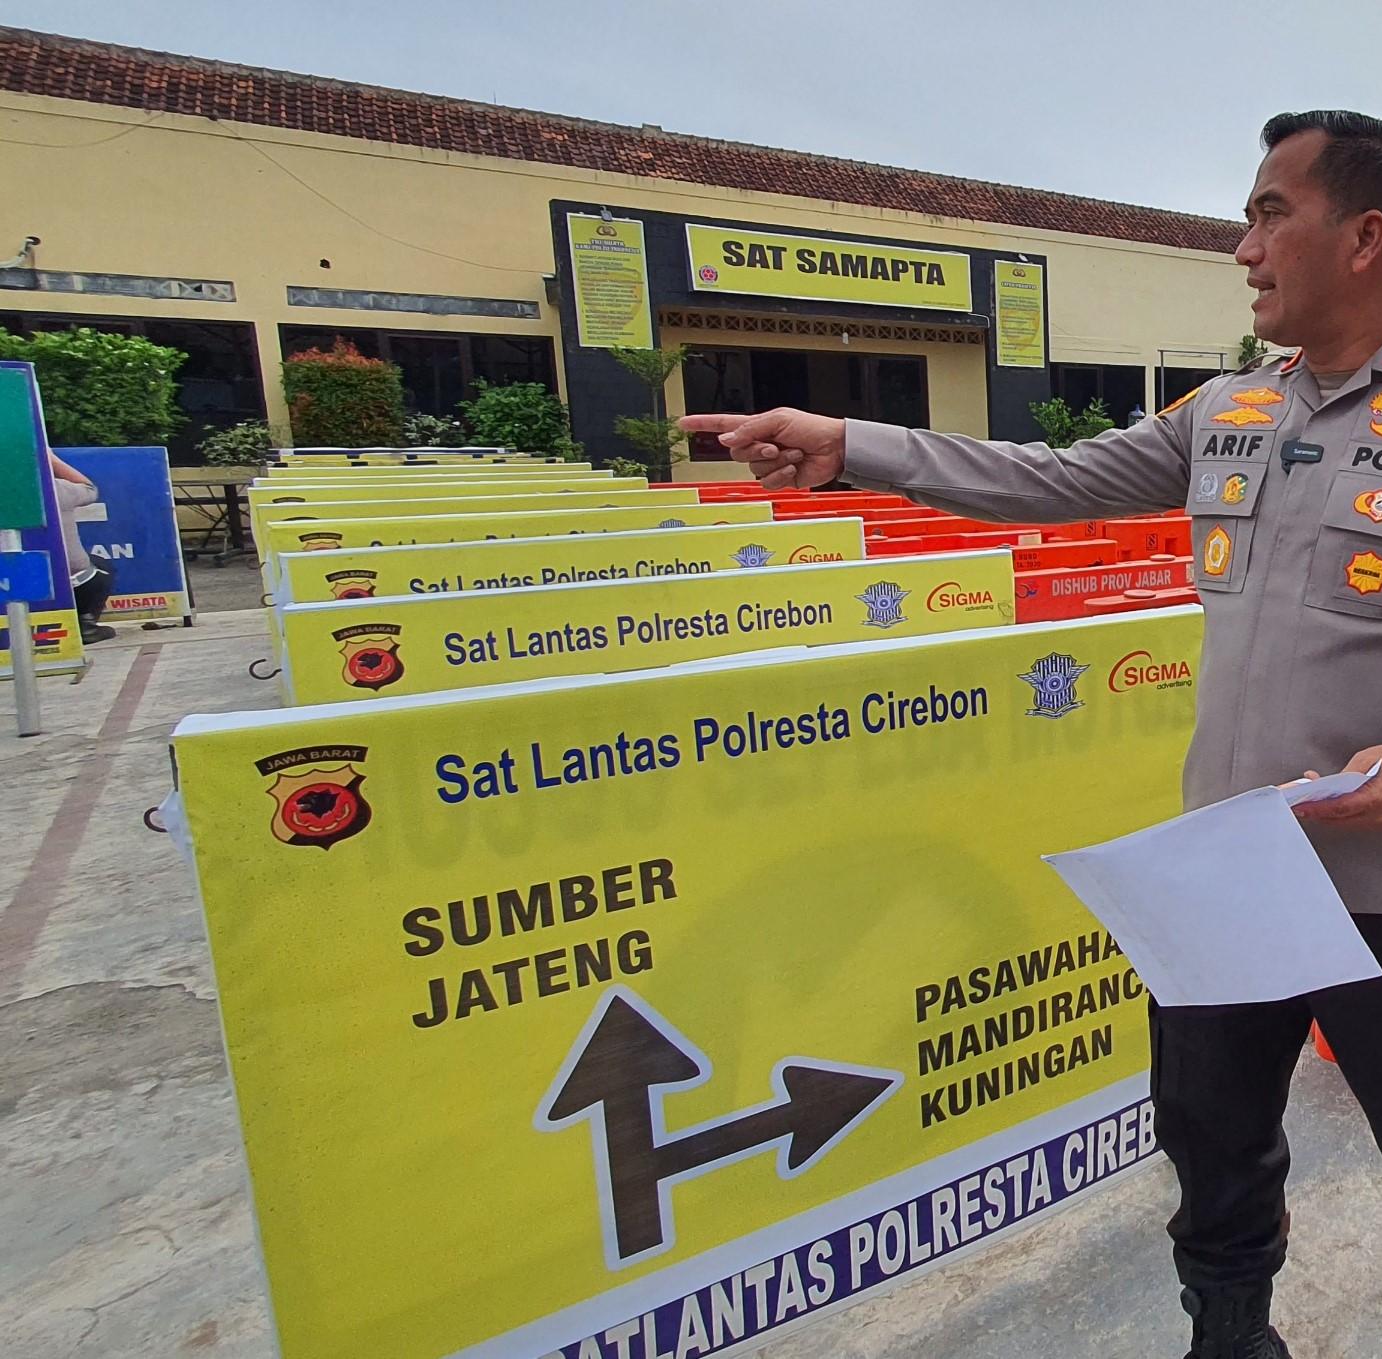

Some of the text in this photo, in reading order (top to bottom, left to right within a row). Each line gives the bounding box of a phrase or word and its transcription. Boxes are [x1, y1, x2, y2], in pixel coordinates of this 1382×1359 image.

[722, 240, 946, 286] SAT SAMAPTA
[1202, 434, 1264, 458] ARIF
[110, 595, 167, 609] WISATA
[938, 590, 993, 608] SIGMA
[1052, 569, 1171, 596] DISHUB PROV JABAR
[444, 598, 833, 666] Sat Lantas Polresta Cirebon
[1124, 660, 1192, 686] SIGMA
[266, 749, 361, 770] JAWA BARAT
[435, 683, 989, 804] Sat Lantas Polresta Cirebon
[401, 857, 678, 958] SUMBER
[411, 929, 654, 1030] JATENG
[917, 967, 1150, 1076] MANDIRANC
[919, 1023, 1114, 1129] KUNINGAN
[849, 1146, 1053, 1296] POLRESTA
